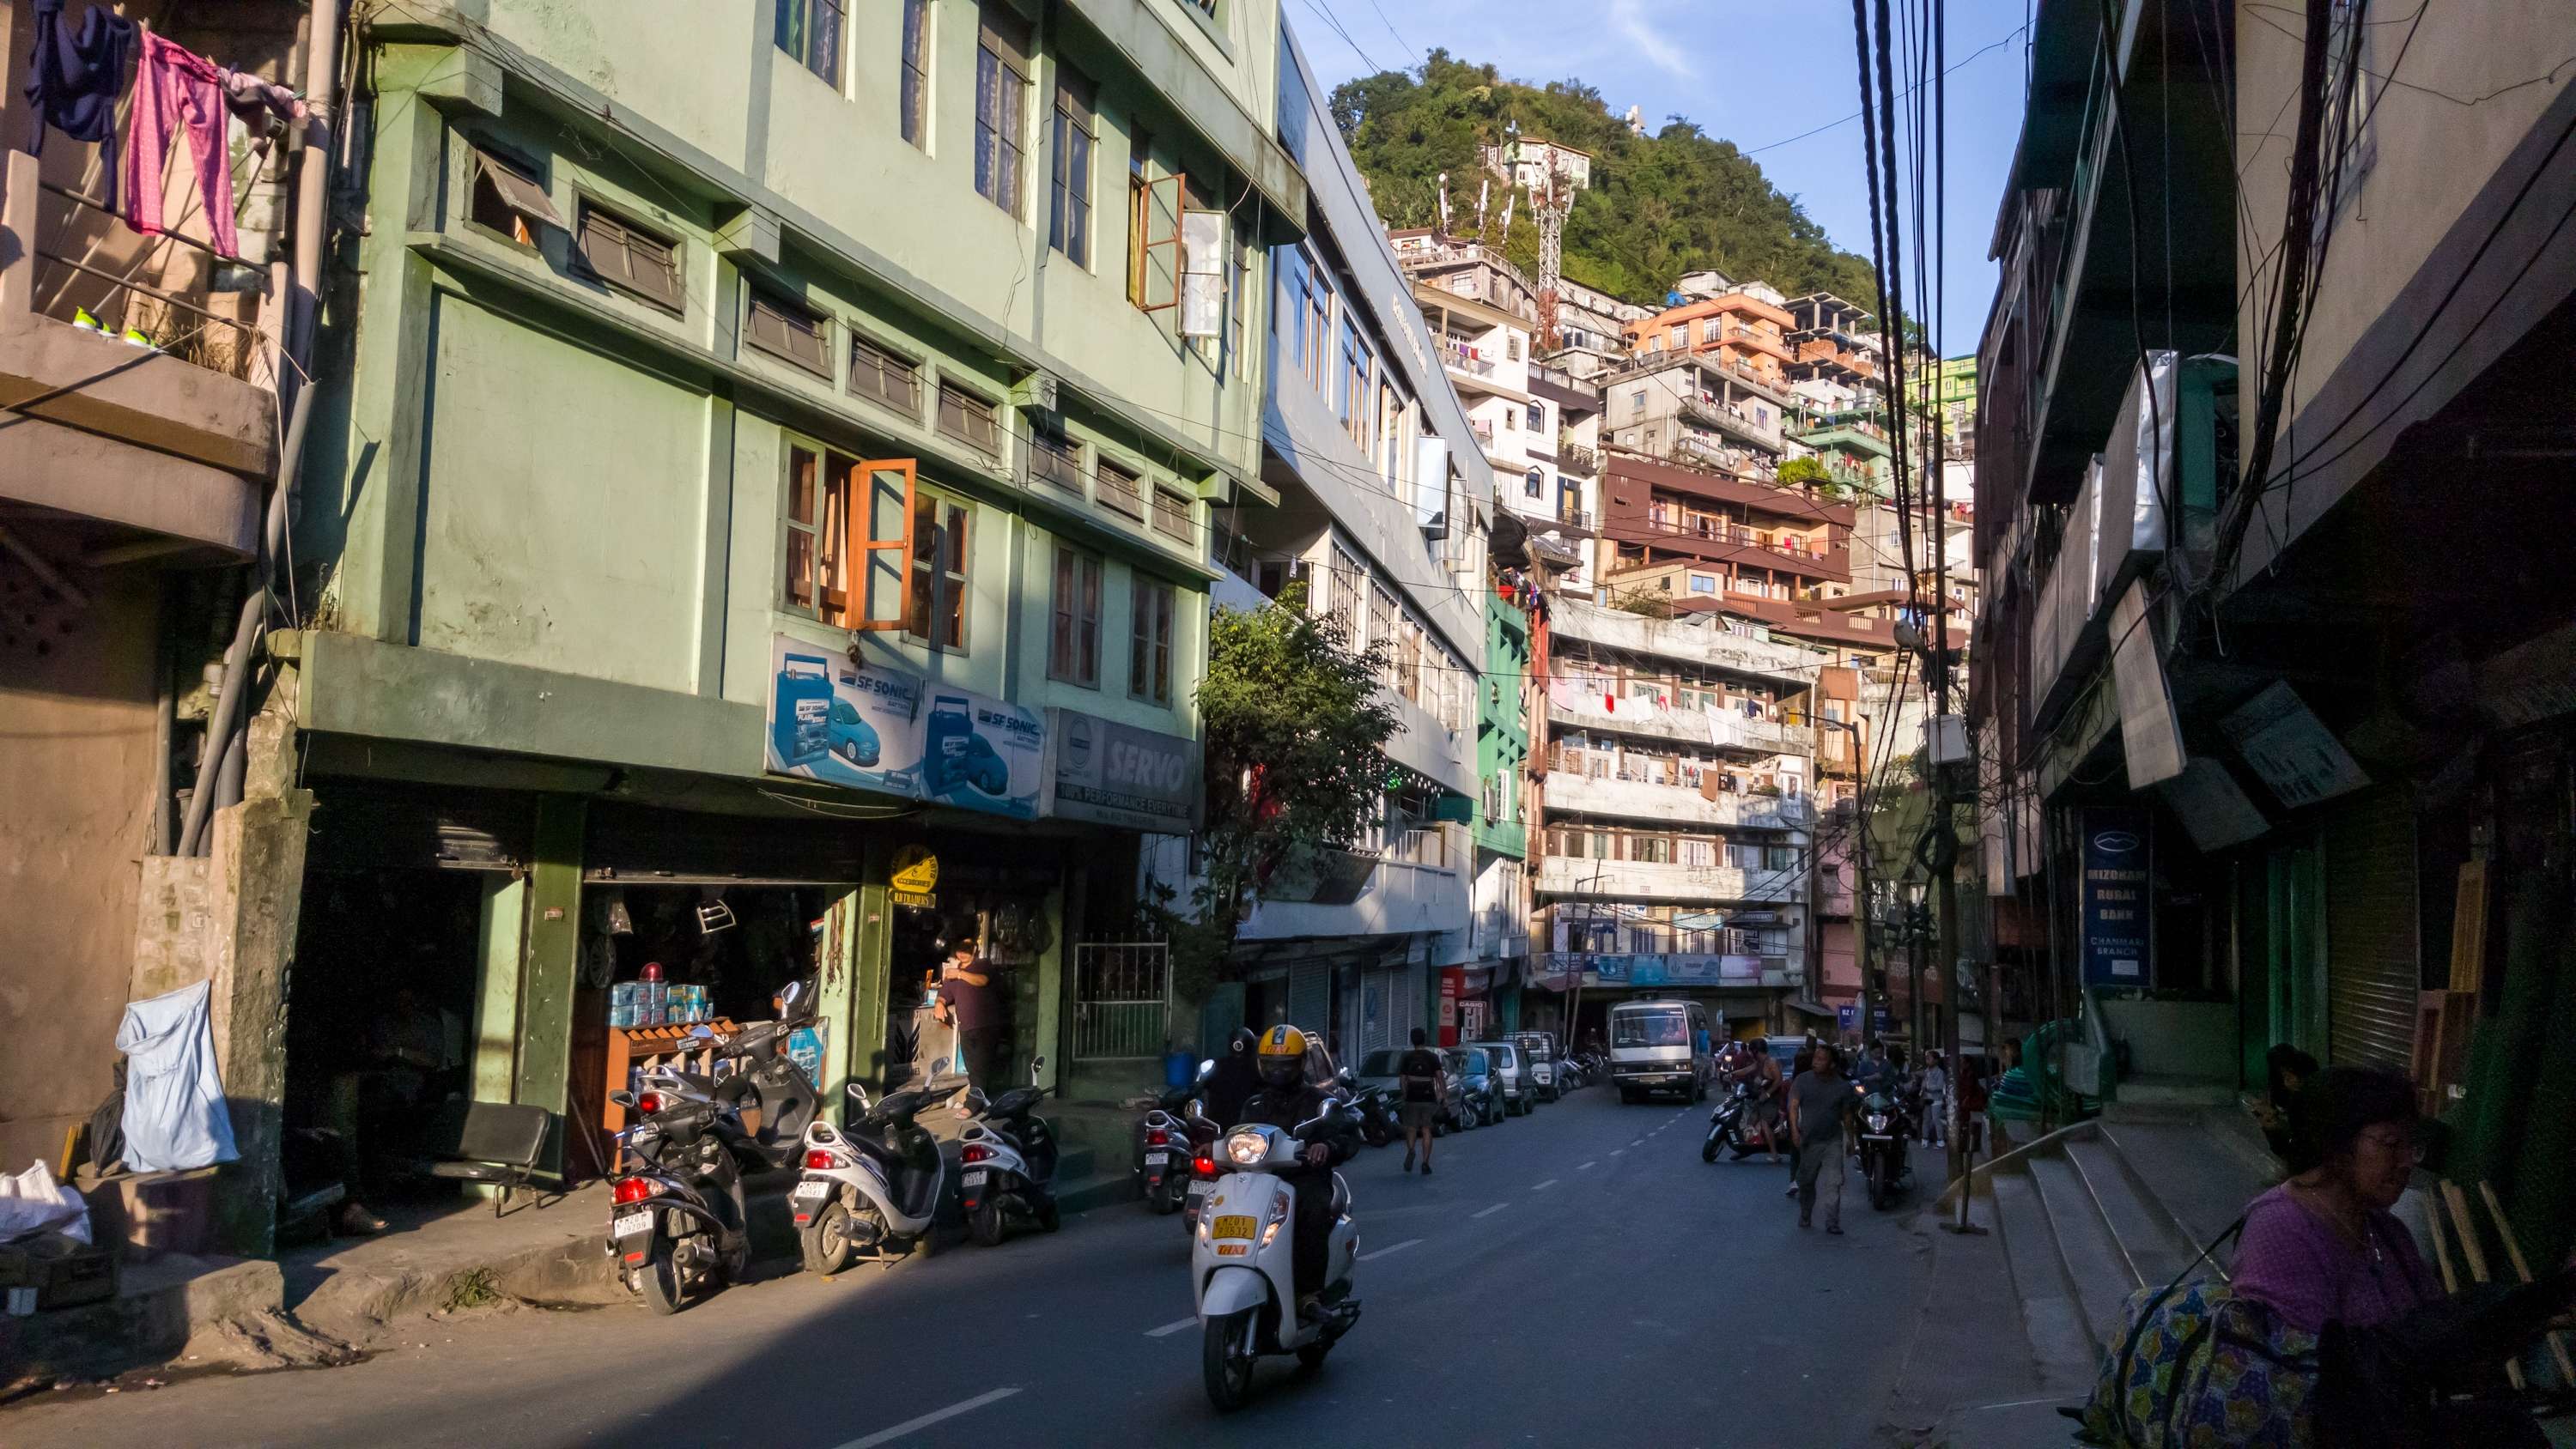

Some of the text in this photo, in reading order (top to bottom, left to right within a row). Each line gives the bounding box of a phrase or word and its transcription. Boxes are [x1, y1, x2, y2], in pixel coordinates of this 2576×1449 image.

[857, 675, 913, 700] SF SONIC
[992, 712, 1040, 736] SF SONIC
[1108, 740, 1185, 791] SERVO
[1060, 784, 1188, 818] 100% PERFORMANCE EVERYTIME
[2087, 870, 2146, 881] MIZORAM
[897, 878, 931, 887] ACCESSORIES
[2097, 889, 2137, 900] RURAL
[2100, 909, 2134, 920] BANK
[2097, 947, 2137, 955] BRANCH
